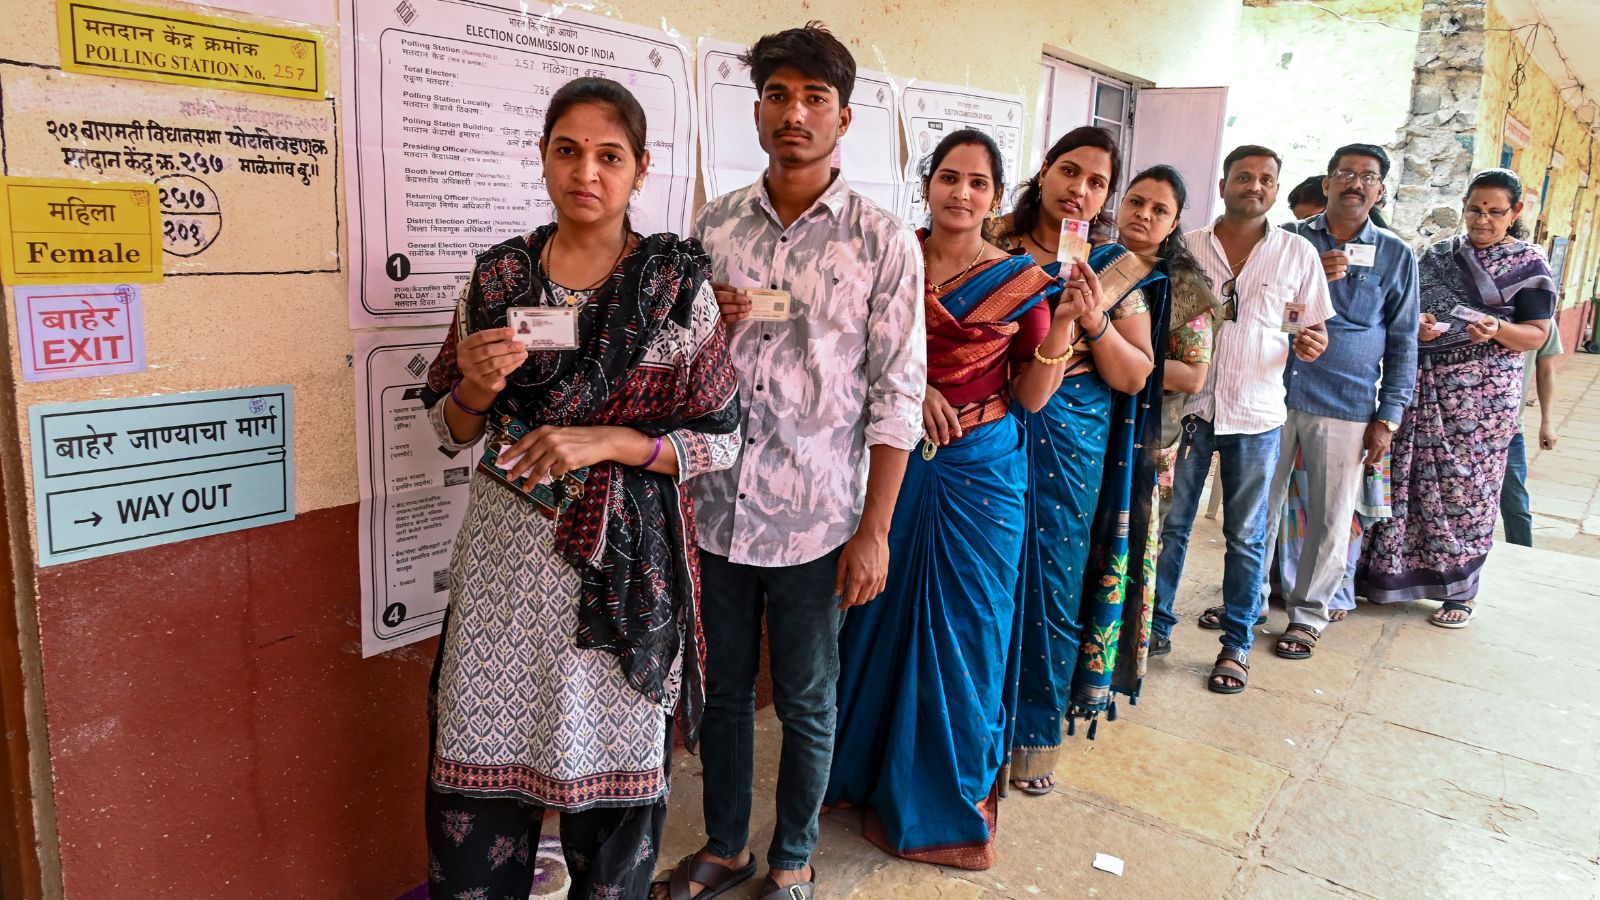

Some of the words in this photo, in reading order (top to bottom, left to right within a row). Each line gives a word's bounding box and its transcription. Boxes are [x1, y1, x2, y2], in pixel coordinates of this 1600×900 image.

[83, 19, 155, 42] मतदान
[163, 25, 195, 49] केंद्र
[203, 37, 260, 56] क्रमांक
[401, 39, 431, 50] Polling
[433, 43, 460, 54] Station
[466, 24, 513, 43] ELECTION
[515, 34, 575, 55] COMMISSION
[577, 45, 589, 57] OF
[591, 48, 615, 61] INDIA
[85, 44, 166, 68] POLLING
[171, 55, 239, 77] STATION
[244, 65, 266, 80] No.
[273, 64, 305, 80] 257
[402, 48, 428, 58] मतदान
[403, 64, 423, 73] Total
[425, 68, 459, 78] Electors:
[402, 90, 432, 101] Polling
[433, 94, 460, 104] Station
[462, 98, 494, 108] Locality:
[402, 100, 429, 109] मतदान
[46, 120, 78, 142] २०१
[81, 120, 144, 144] बारामती
[146, 119, 221, 147] विधानसभा
[402, 116, 432, 126] Polling
[433, 119, 460, 129] Station
[462, 122, 495, 133] Building:
[402, 126, 428, 134] मतदान
[402, 142, 440, 152] Presiding
[442, 145, 468, 153] Officer
[61, 147, 121, 174] मतदान
[404, 167, 428, 175] Booth
[448, 170, 474, 178] Officer
[159, 188, 205, 210] २५७
[405, 192, 442, 202] Returning
[444, 194, 469, 202] Officer
[47, 196, 117, 226] महिला
[406, 217, 434, 225] District
[435, 218, 465, 226] Election
[26, 242, 140, 263] Female
[393, 256, 402, 278] 1
[38, 300, 120, 331] बाहेर
[43, 335, 125, 365] EXIT
[53, 424, 118, 460] बाहेर
[127, 420, 227, 450] जाण्याचा
[236, 405, 278, 437] मार्ग
[116, 492, 175, 524] WAY
[182, 483, 232, 513] OUT
[388, 606, 400, 623] 4
